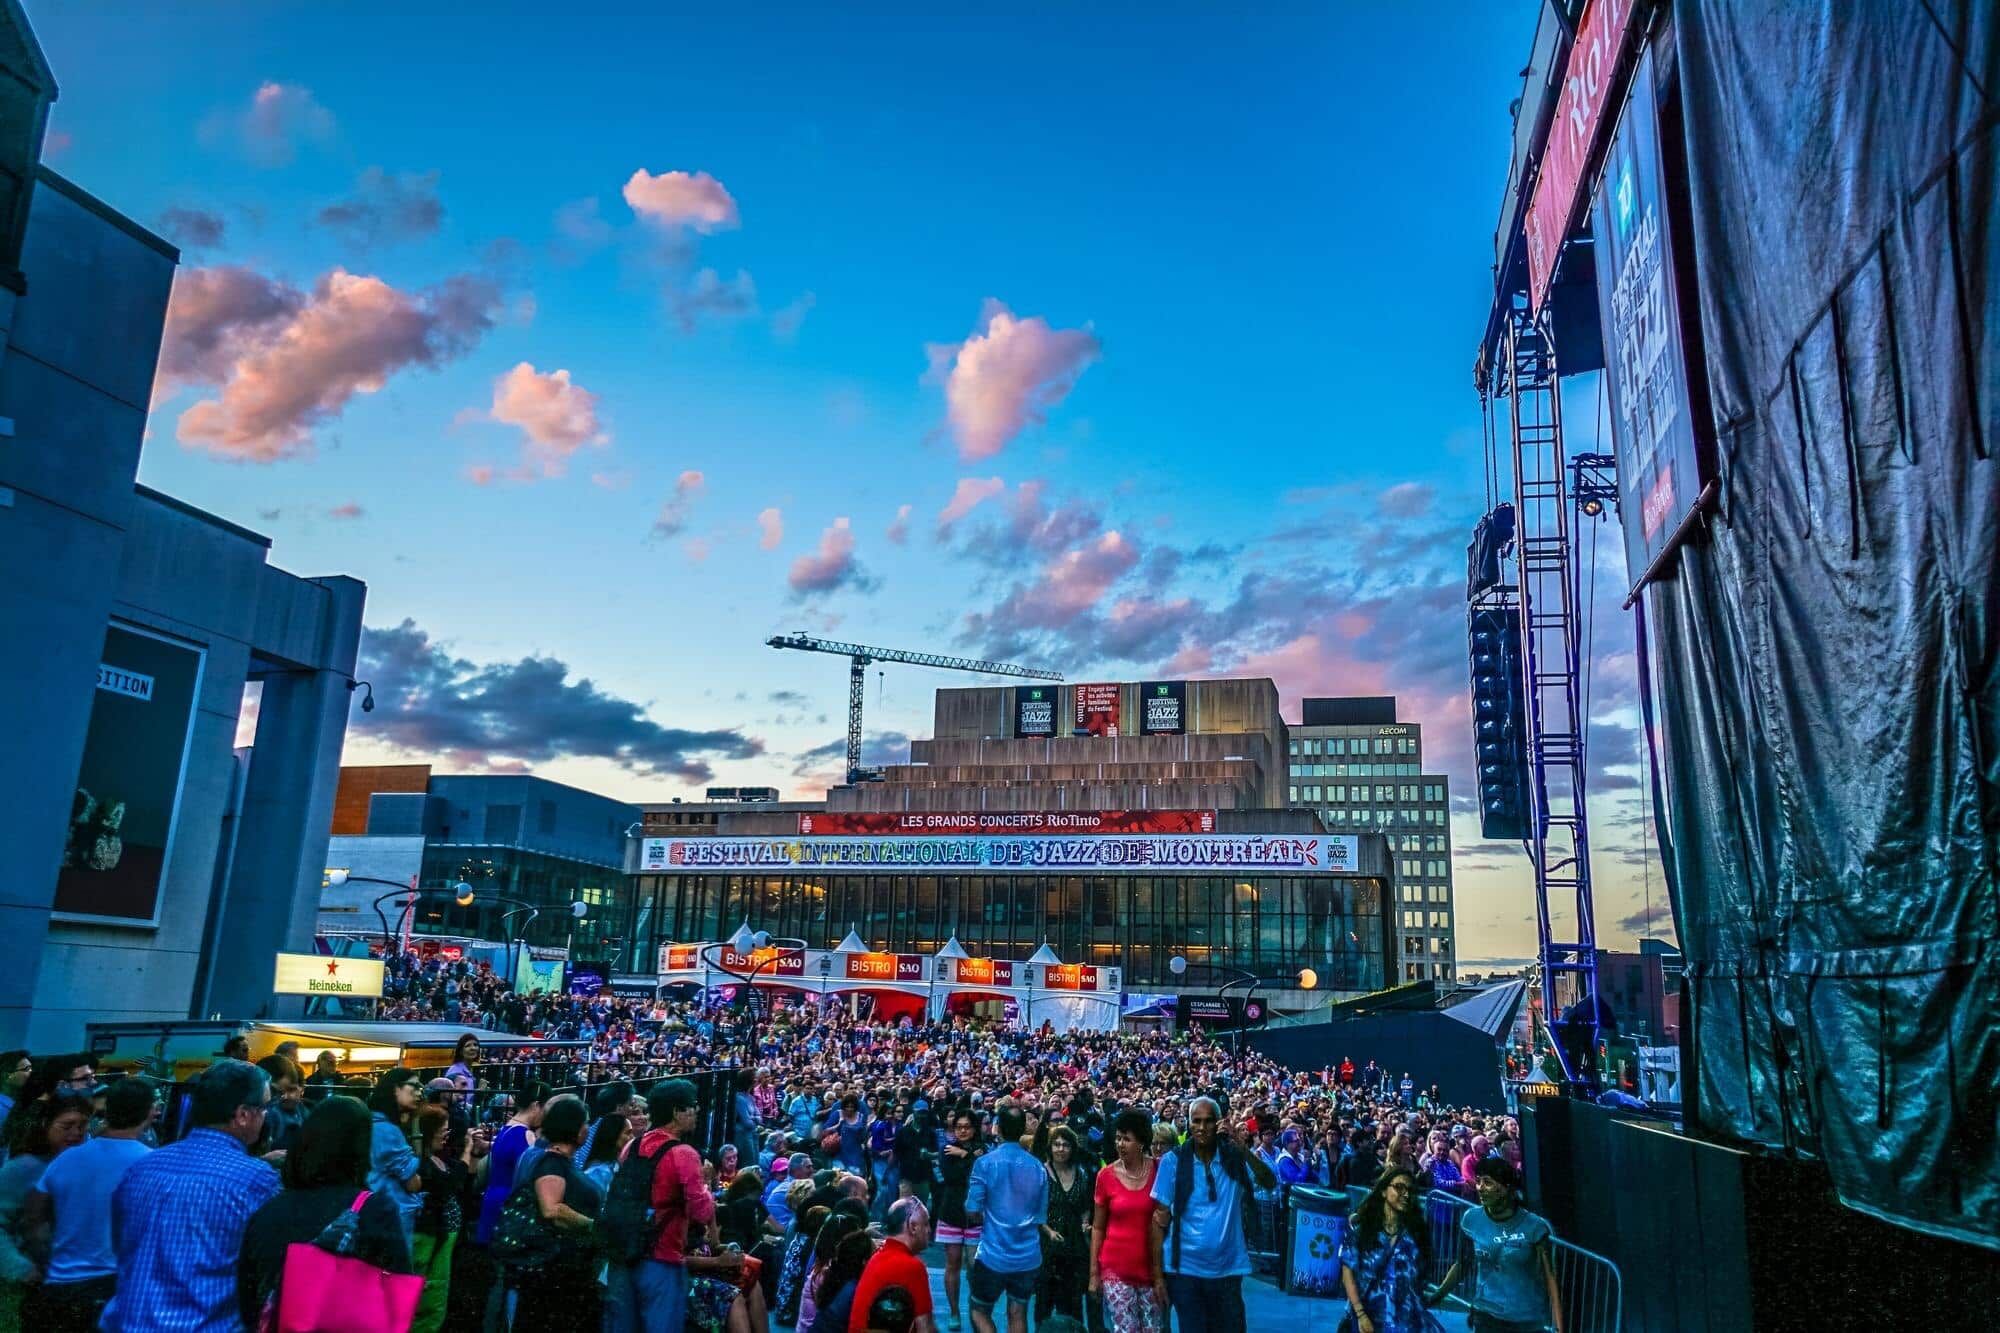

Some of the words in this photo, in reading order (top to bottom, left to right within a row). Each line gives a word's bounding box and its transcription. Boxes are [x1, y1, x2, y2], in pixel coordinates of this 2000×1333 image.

[1022, 711, 1051, 722] JAZZ
[1148, 707, 1179, 719] JAZZ
[901, 816, 923, 827] LES
[927, 816, 976, 827] GRANDS
[980, 815, 1043, 826] CONCERTS
[683, 842, 791, 864] FESTIVAL
[799, 842, 979, 864] INTERNATIONAL
[991, 843, 1022, 863] DE
[1034, 842, 1096, 864] JAZZ
[1111, 842, 1140, 863] DE
[1152, 837, 1303, 864] MONTRÉAL
[726, 953, 770, 967] BISTRO
[851, 960, 891, 973] BISTRO
[960, 967, 989, 977] BISTRO
[1048, 972, 1076, 983] BISTRO
[309, 979, 352, 992] Heineken
